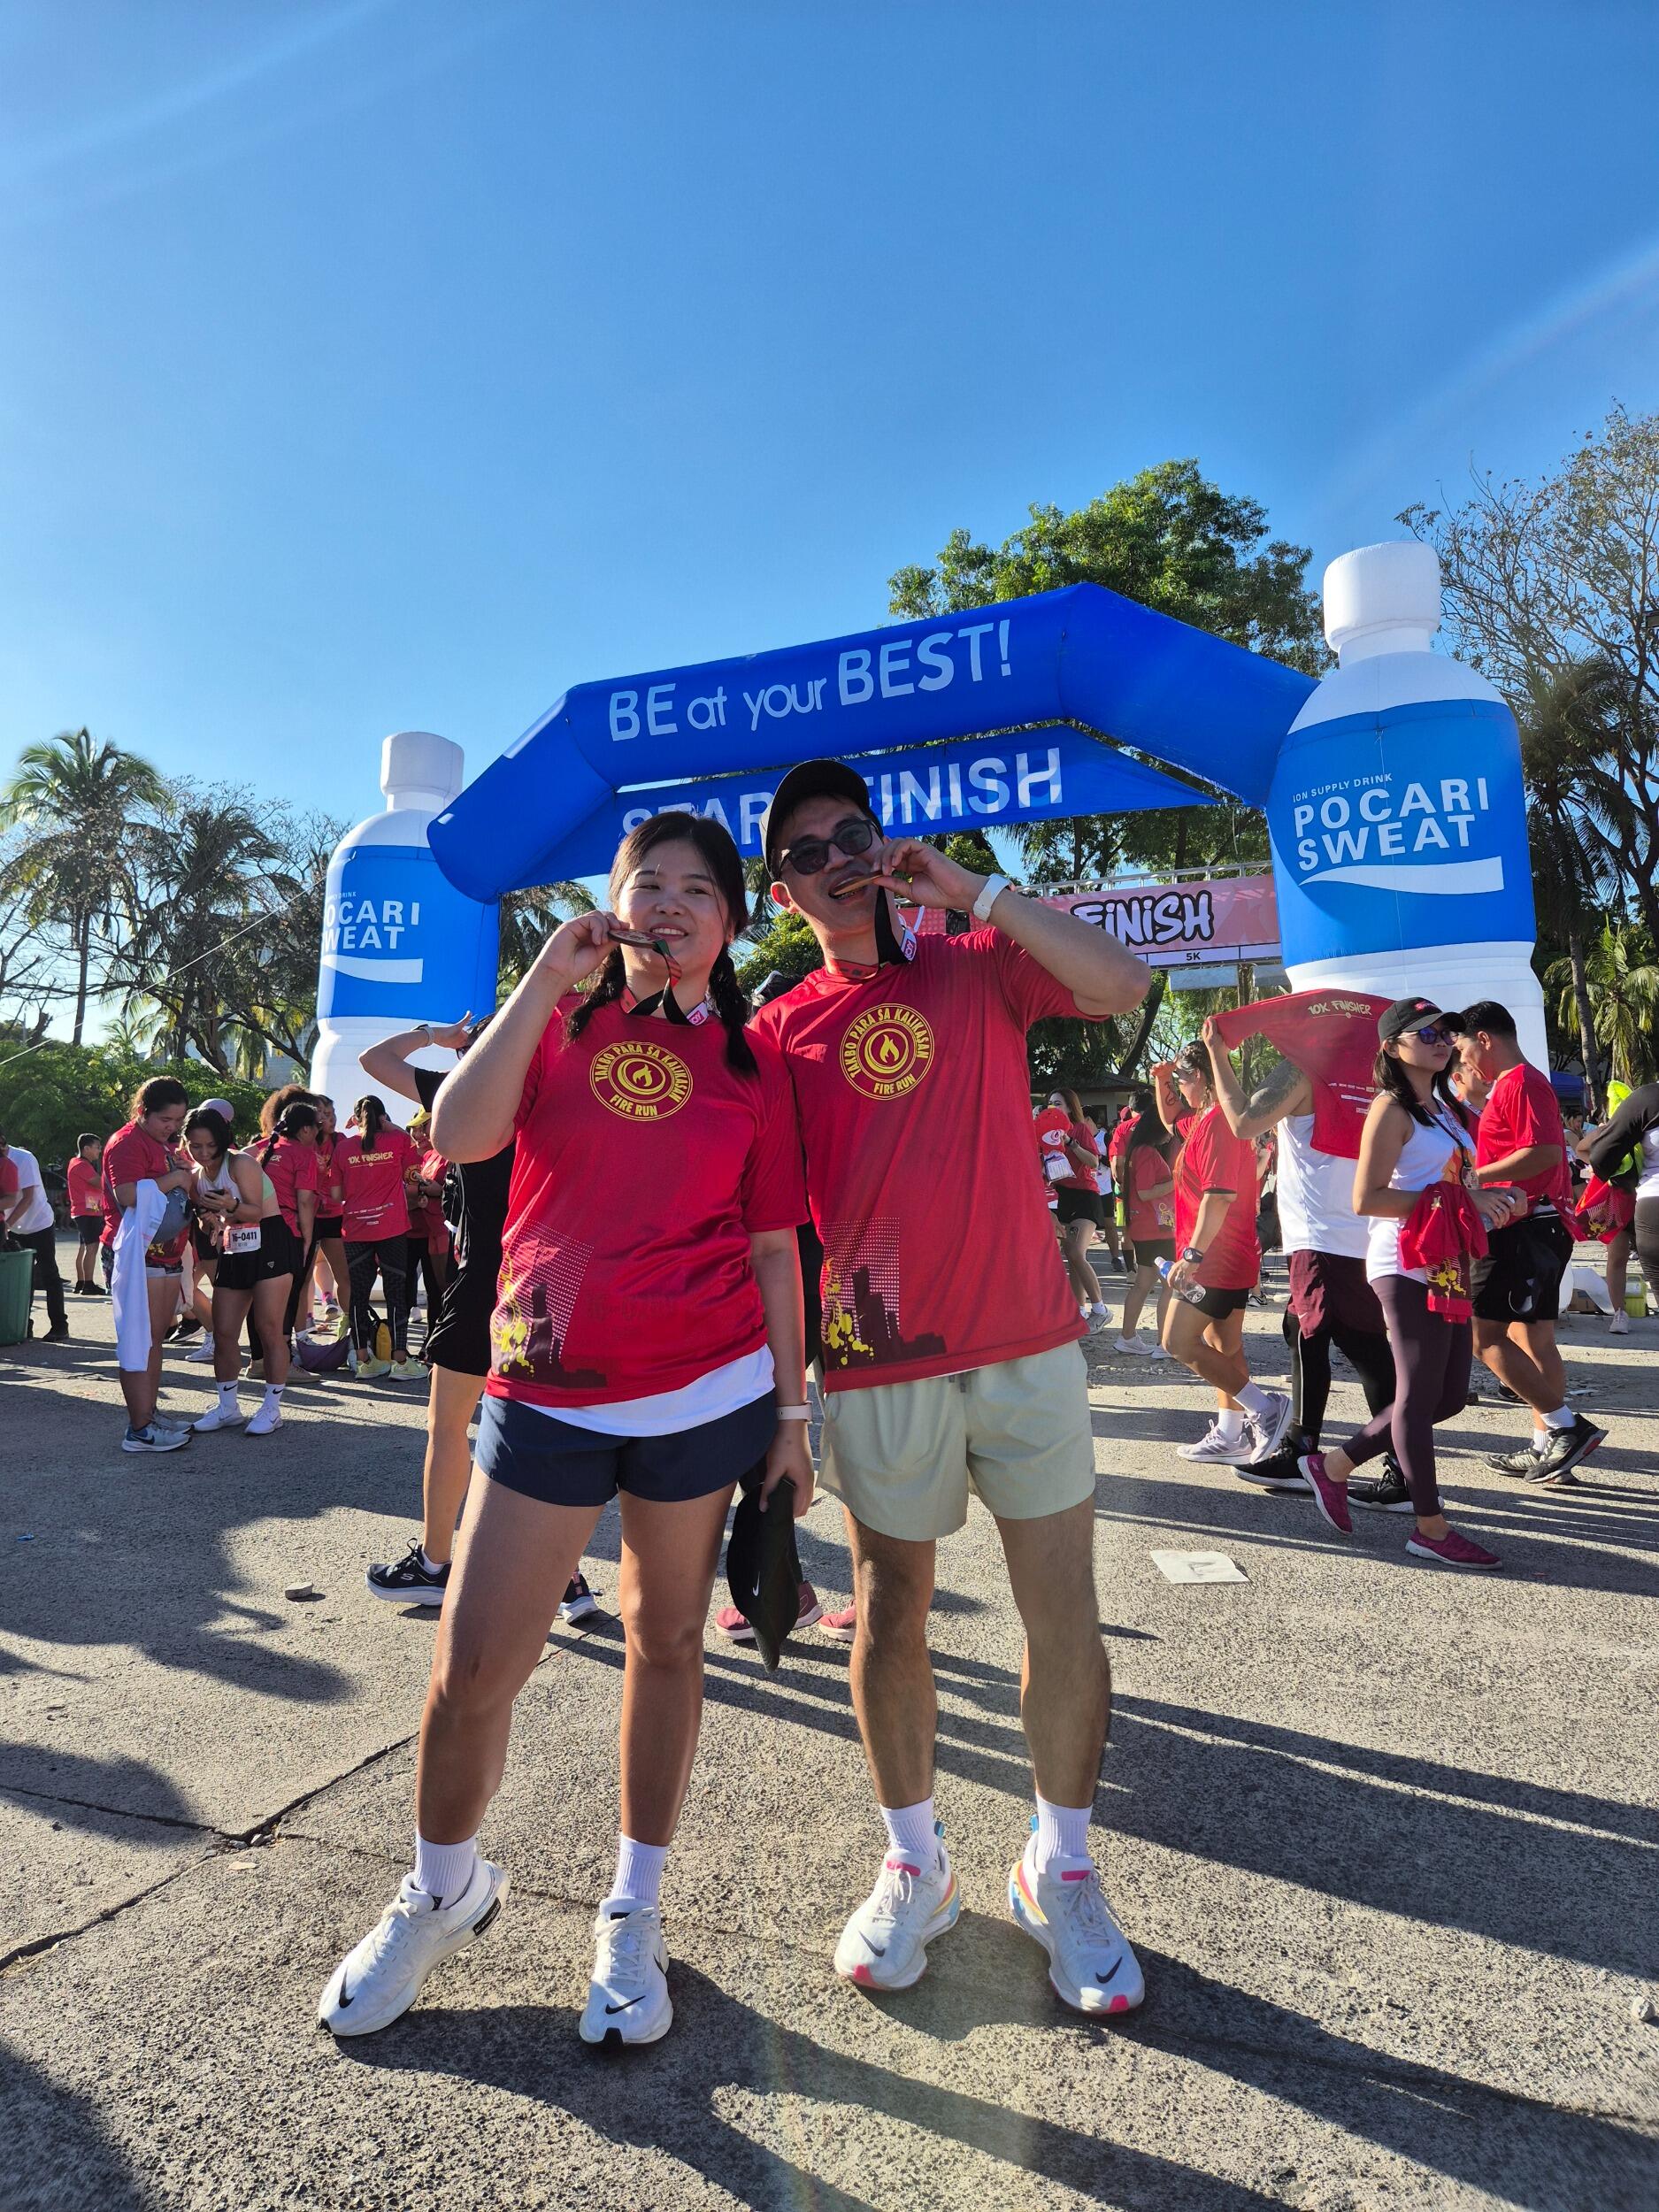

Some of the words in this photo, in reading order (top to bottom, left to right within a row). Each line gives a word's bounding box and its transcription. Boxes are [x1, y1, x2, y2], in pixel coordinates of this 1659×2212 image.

[609, 682, 679, 742] BE
[687, 686, 728, 730] at
[742, 677, 827, 732] your
[838, 618, 1012, 706] BEST!
[1293, 791, 1309, 803] ION
[1311, 780, 1350, 797] SUPPLY
[1354, 772, 1394, 787] DRINK
[1294, 777, 1490, 838] POCARI
[1297, 814, 1476, 872] SWEAT
[325, 900, 420, 927] OCARI
[323, 925, 405, 953] WEAT
[1186, 951, 1202, 962] 5K
[877, 1008, 891, 1021] SA
[1308, 1002, 1331, 1015] 10K
[1330, 1000, 1372, 1016] FINISHER
[849, 1013, 876, 1040] PARA
[894, 1008, 930, 1059] KALIKASAN
[594, 1052, 616, 1082] TAKBO
[612, 1043, 643, 1055] PARA
[646, 1046, 661, 1058] SA
[661, 1055, 688, 1103] KALIKASAN
[844, 1042, 862, 1079] TAKBO
[873, 1082, 895, 1094] FIRE
[895, 1072, 917, 1092] RUN
[609, 1094, 634, 1113] FIRE
[634, 1103, 658, 1117] RUN
[348, 1156, 361, 1164] 10K
[361, 1151, 394, 1162] FINISHER
